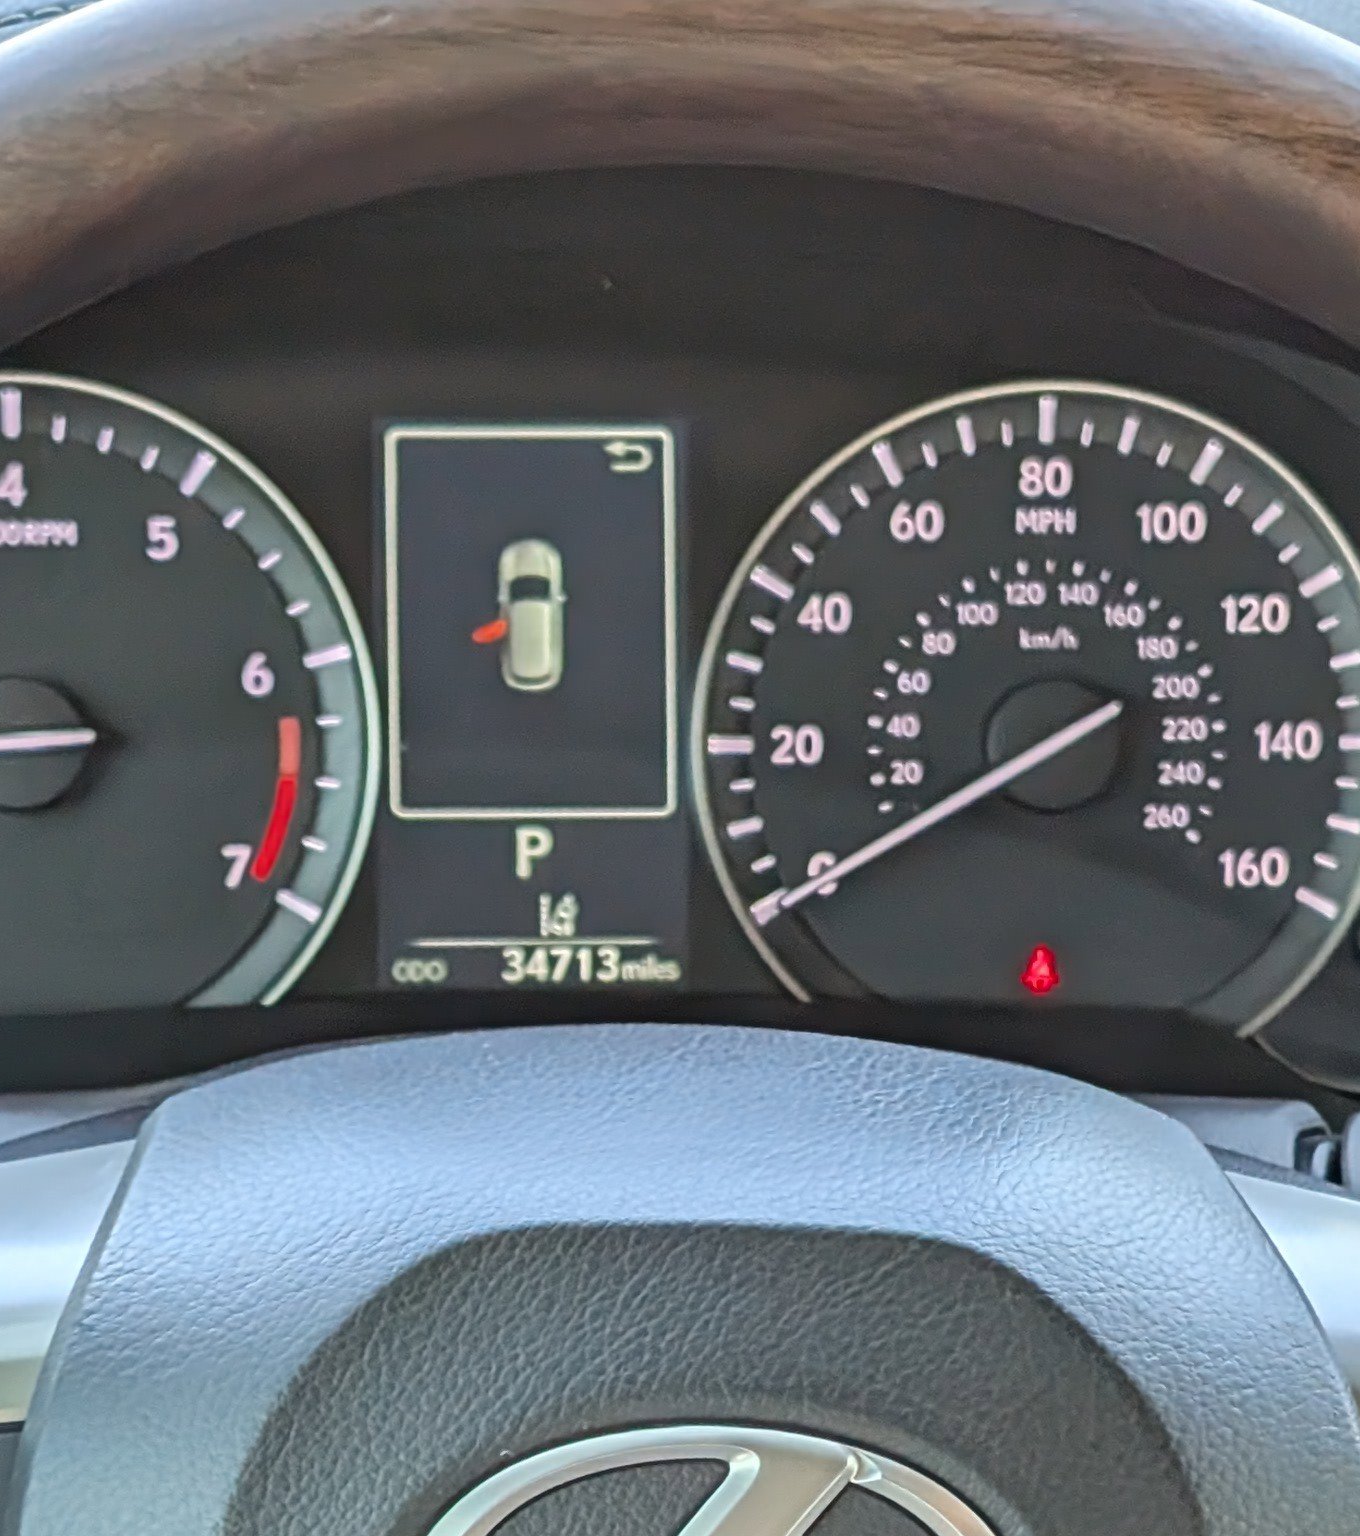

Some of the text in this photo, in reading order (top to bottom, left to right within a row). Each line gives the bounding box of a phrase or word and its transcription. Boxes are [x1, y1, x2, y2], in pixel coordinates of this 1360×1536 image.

[1019, 458, 1072, 497] 80
[890, 502, 943, 541] 60
[1016, 508, 1076, 534] MPH
[1137, 503, 1206, 542] 100
[147, 516, 178, 561] 5
[1005, 582, 1046, 605] 120
[1059, 583, 1099, 605] 140
[797, 594, 851, 633] 40
[957, 602, 998, 625] 100
[1104, 604, 1145, 627] 160
[1221, 594, 1289, 633] 120
[922, 632, 955, 654] 80
[1020, 627, 1077, 649] km/h
[1138, 637, 1178, 659] 180
[242, 653, 274, 697] 6
[897, 672, 930, 693] 60
[1153, 675, 1199, 698] 200
[887, 715, 920, 738] 40
[1163, 717, 1208, 741] 220
[771, 725, 823, 764] 20
[1255, 721, 1322, 760] 140
[891, 762, 923, 784] 20
[1159, 762, 1204, 785] 240
[1144, 804, 1189, 828] 260
[516, 827, 552, 878] P
[222, 844, 252, 888] 7
[1219, 848, 1289, 887] 160
[502, 947, 619, 982] 34713
